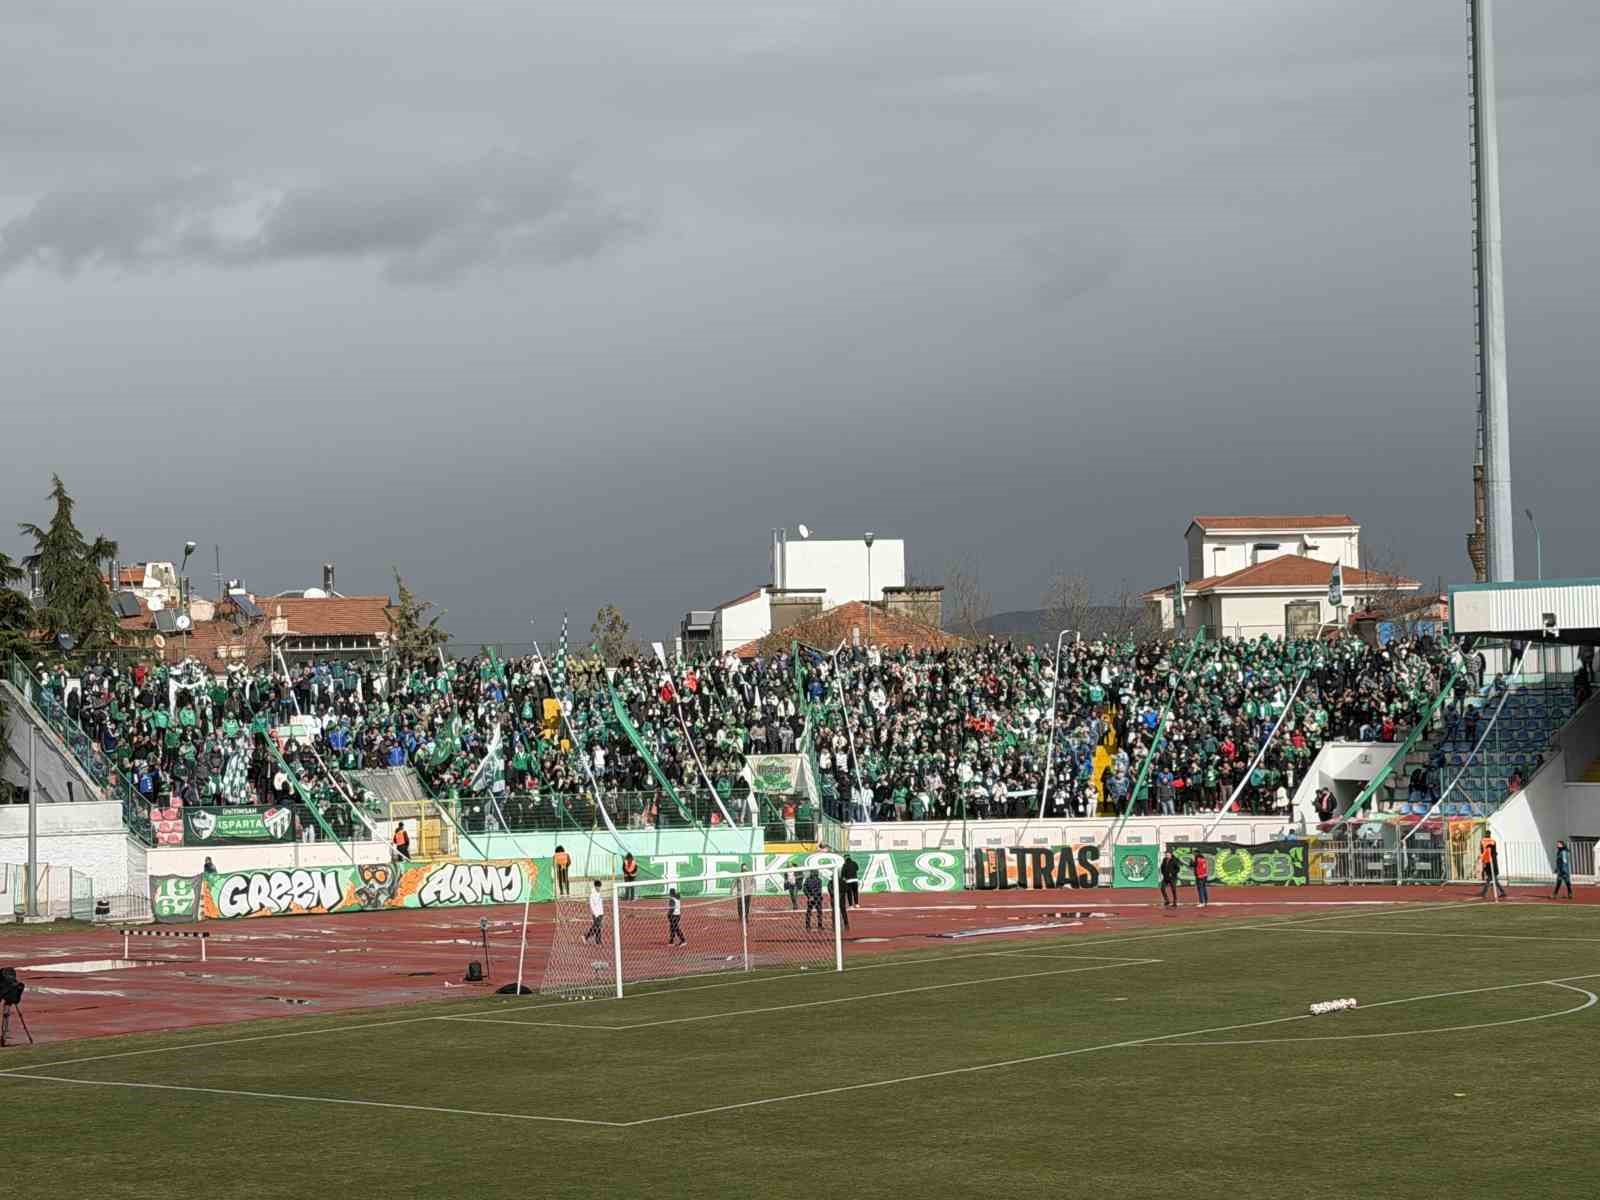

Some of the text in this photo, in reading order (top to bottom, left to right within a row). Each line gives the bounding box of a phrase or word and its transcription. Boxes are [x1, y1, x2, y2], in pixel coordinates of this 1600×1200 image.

[160, 879, 193, 896] 19
[418, 862, 523, 908] ARMY
[649, 852, 957, 895] TEKSAS
[974, 845, 1100, 890] ULTRAS
[159, 897, 193, 916] 67
